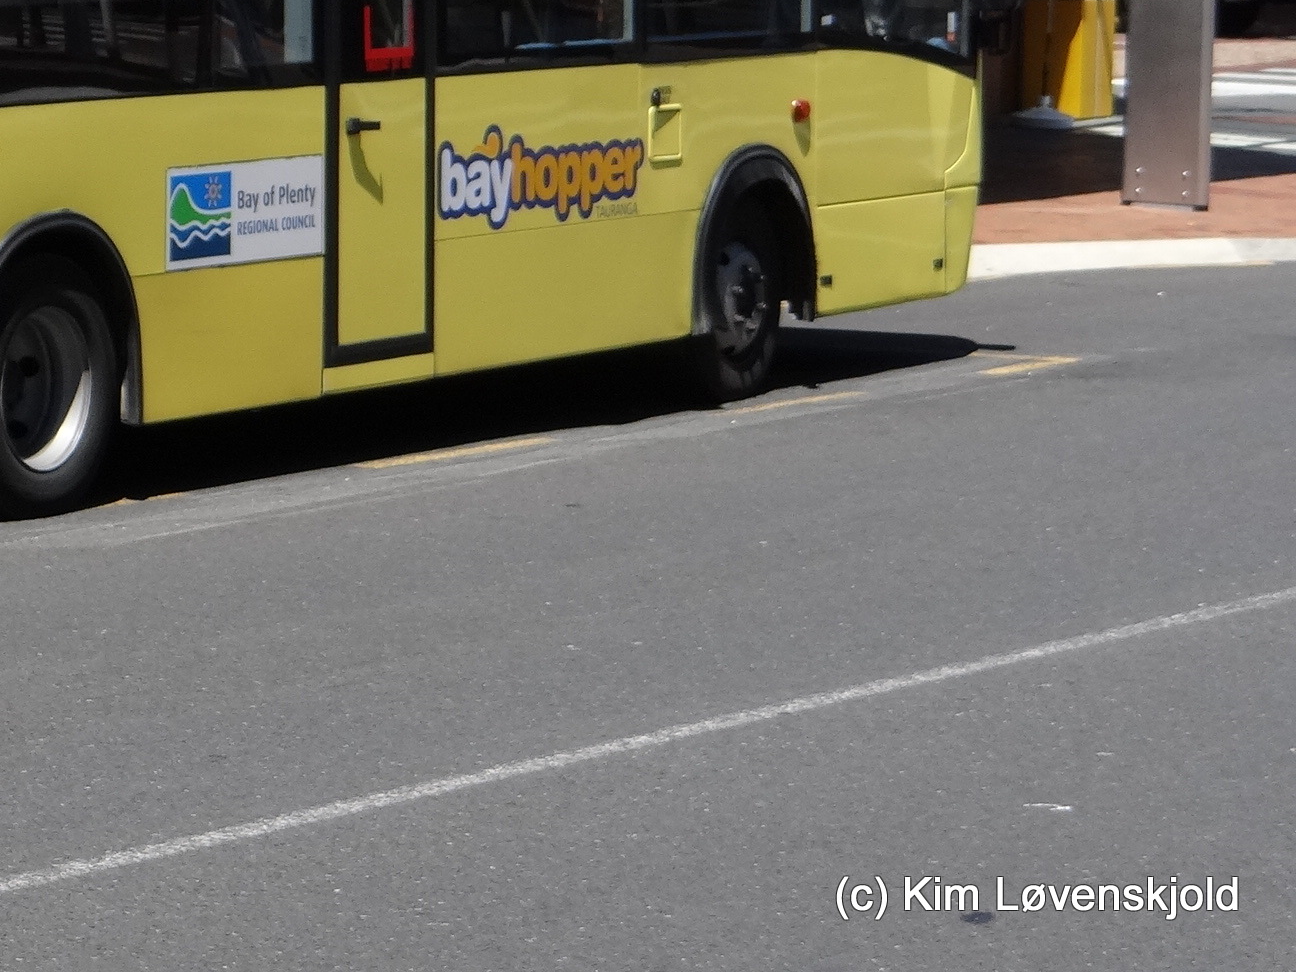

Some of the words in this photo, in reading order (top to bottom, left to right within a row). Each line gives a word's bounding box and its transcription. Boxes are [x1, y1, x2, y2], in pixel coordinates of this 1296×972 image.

[438, 134, 643, 229] bayhopper
[237, 189, 259, 213] Bay
[262, 184, 277, 207] of
[278, 182, 316, 208] Plenty
[595, 201, 638, 219] TAURANGA
[236, 216, 279, 236] REGIONAL
[281, 213, 316, 232] COUNCIL
